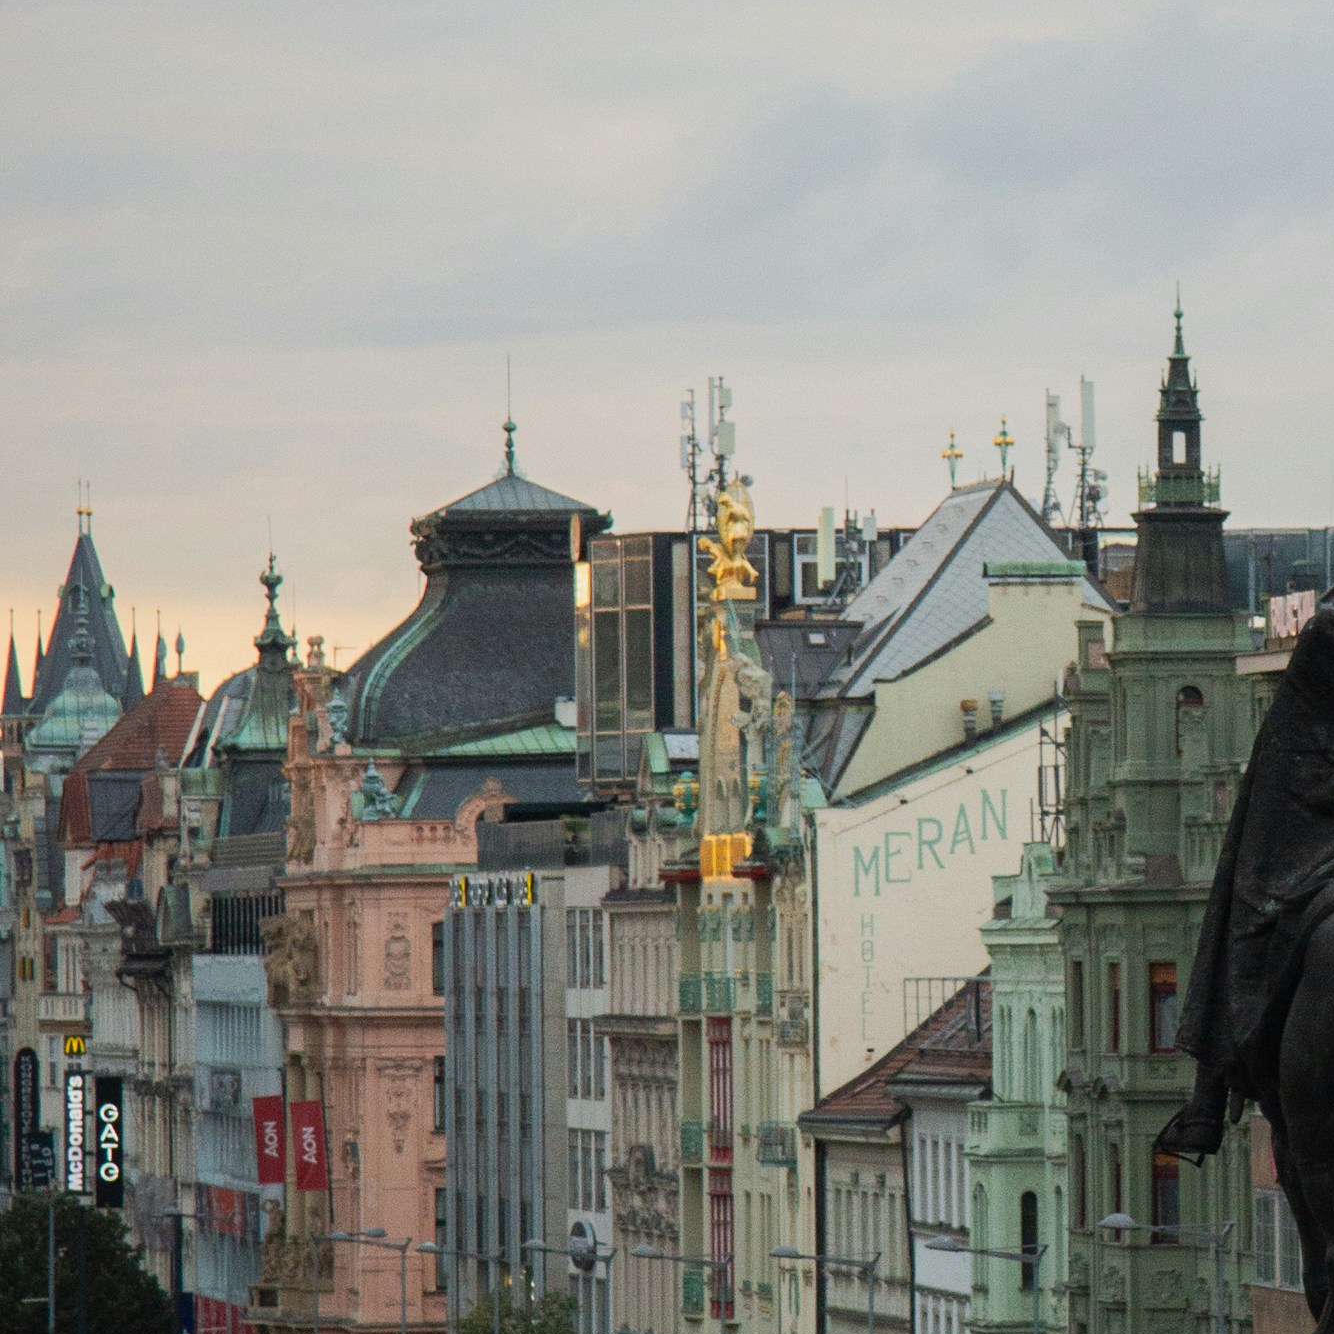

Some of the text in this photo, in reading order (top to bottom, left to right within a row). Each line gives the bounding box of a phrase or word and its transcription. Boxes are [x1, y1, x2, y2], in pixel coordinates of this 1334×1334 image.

[853, 788, 1008, 897] MERAN
[67, 1074, 84, 1191] McDonald's
[263, 1120, 280, 1158] AON
[301, 1126, 318, 1164] AON
